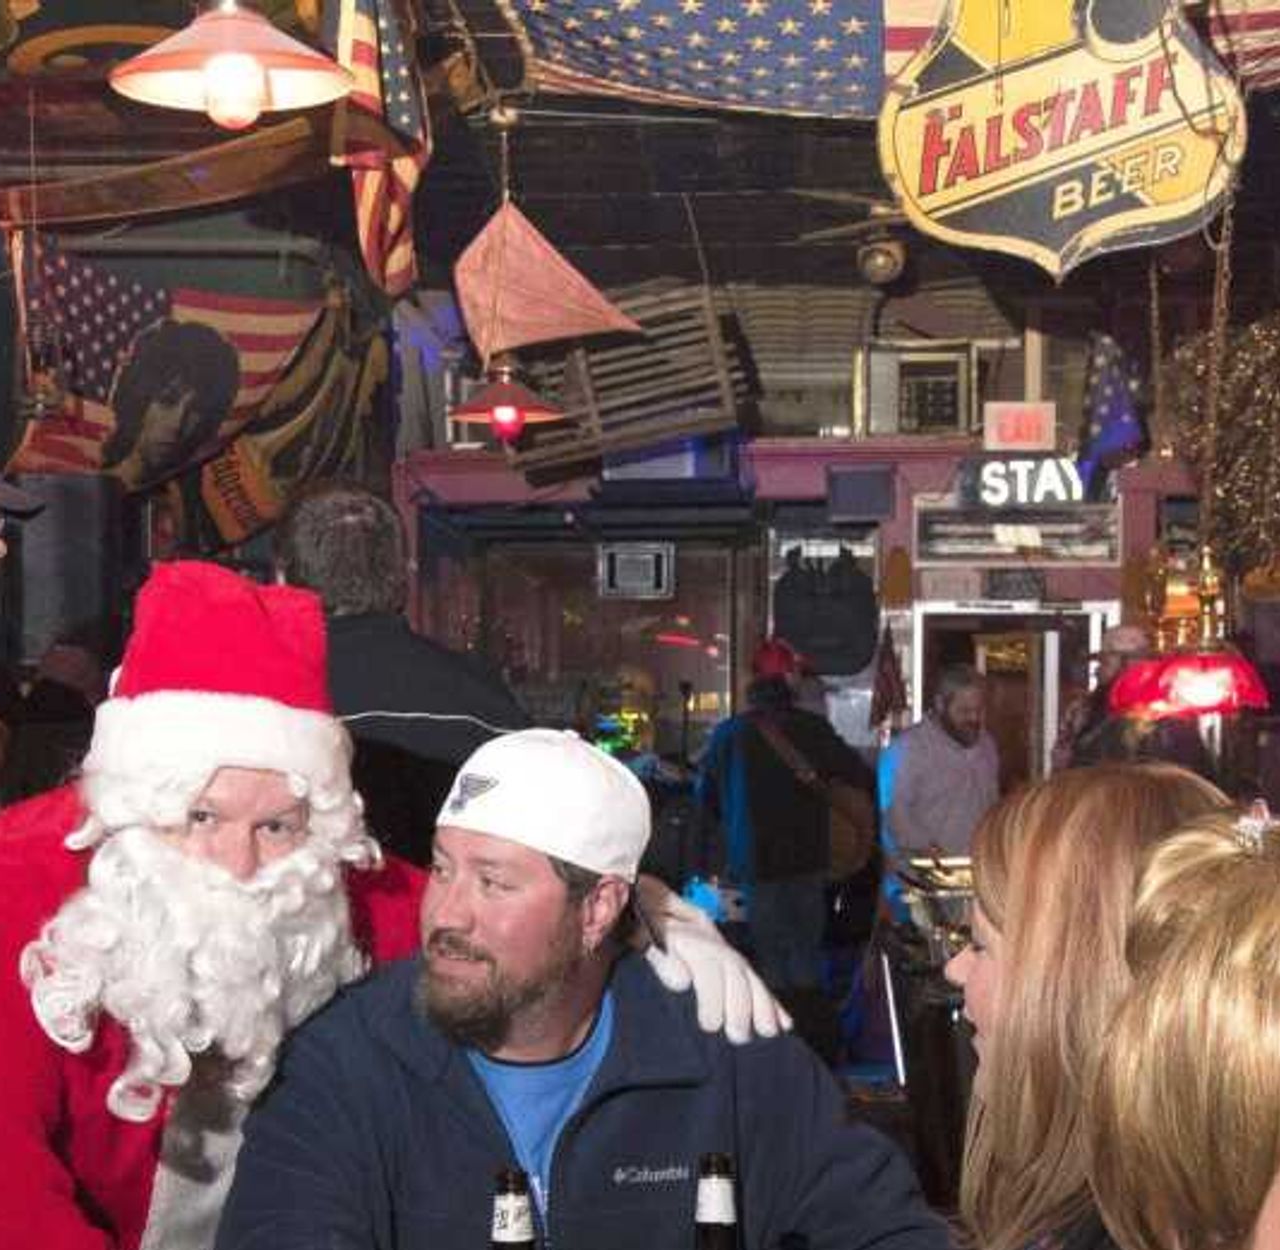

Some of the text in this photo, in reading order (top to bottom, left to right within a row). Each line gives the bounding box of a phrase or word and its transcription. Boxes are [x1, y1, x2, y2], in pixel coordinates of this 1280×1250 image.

[920, 51, 1179, 195] FALSTAFF
[1053, 144, 1183, 220] BEER
[981, 456, 1083, 504] STAY
